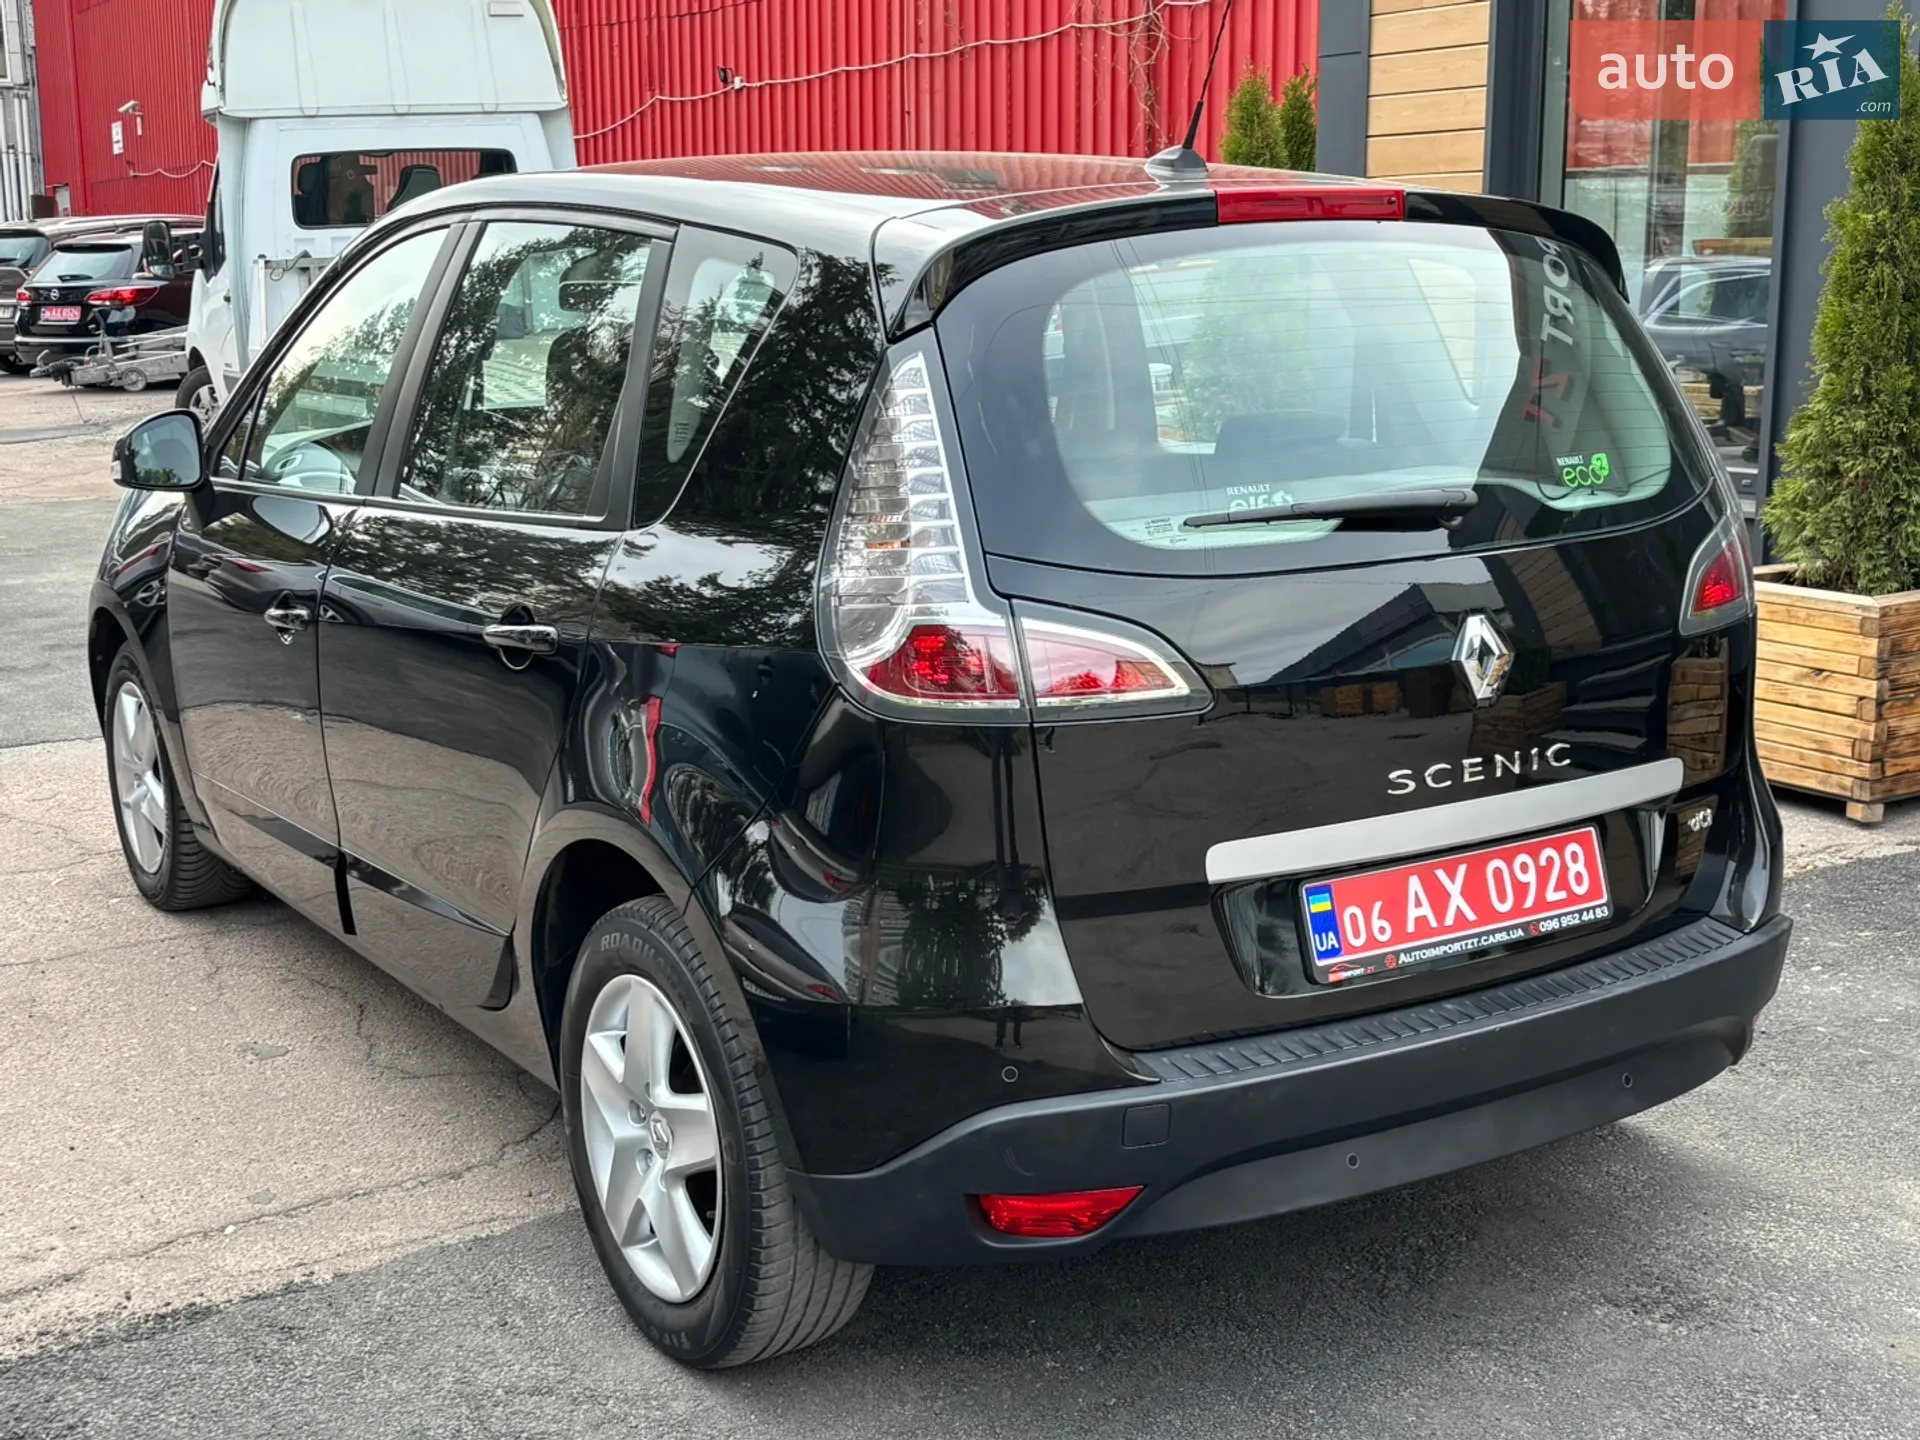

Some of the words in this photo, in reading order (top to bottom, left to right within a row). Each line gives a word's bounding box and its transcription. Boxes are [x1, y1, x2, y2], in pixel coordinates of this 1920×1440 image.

[1226, 484, 1271, 496] RENAULT
[1387, 743, 1571, 795] SCENIC
[1315, 931, 1339, 952] UA
[1343, 900, 1392, 947] 06
[1406, 863, 1478, 933] AX
[1486, 842, 1590, 914] 0928
[1539, 919, 1560, 932] 096
[1561, 915, 1581, 927] 952
[1581, 910, 1595, 922] 44
[1595, 906, 1609, 918] 83
